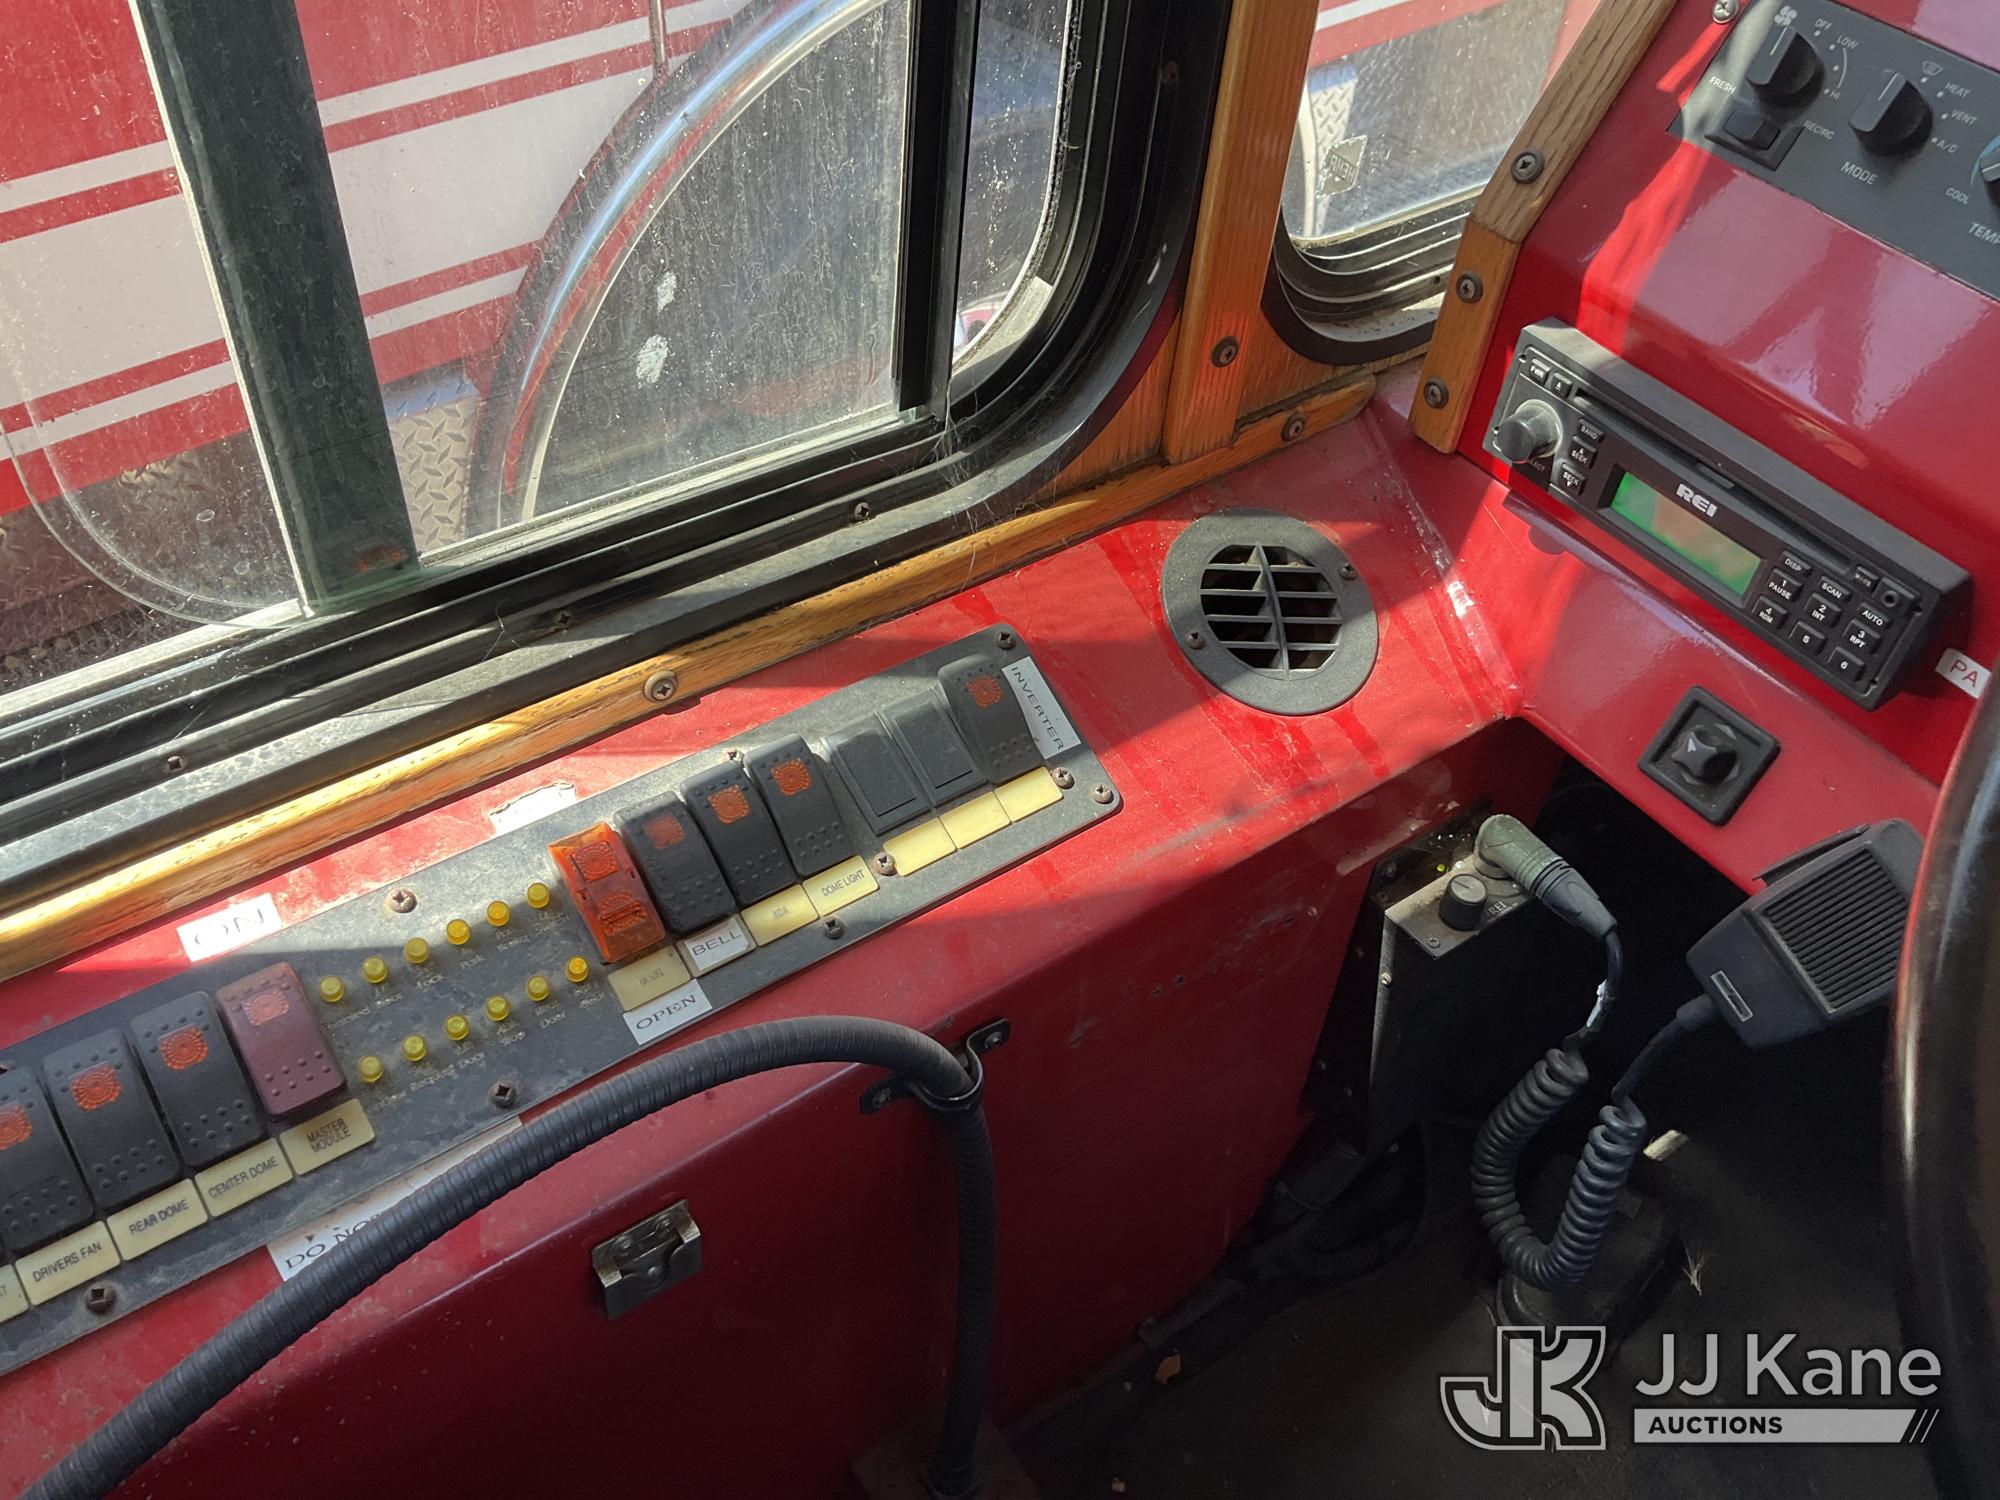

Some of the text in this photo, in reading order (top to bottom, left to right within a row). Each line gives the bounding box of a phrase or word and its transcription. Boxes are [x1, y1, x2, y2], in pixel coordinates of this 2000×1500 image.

[1814, 18, 1833, 31] OFF
[1837, 35, 1859, 50] LOW
[1709, 76, 1737, 94] FRESH
[1945, 82, 1971, 98] HEAT
[1829, 90, 1841, 100] HI
[1950, 108, 1978, 126] VENT
[1803, 120, 1835, 140] RECIRC
[1937, 139, 1959, 154] A/C
[1840, 161, 1878, 185] MODE
[1945, 187, 1970, 205] COOL
[1580, 424, 1599, 441] BAND
[1571, 449, 1588, 465] SEEK
[1562, 471, 1580, 486] SEEK
[1676, 483, 1718, 518] REI
[1784, 557, 1802, 572] DISP
[1768, 582, 1792, 600] PAUSE
[1781, 578, 1788, 588] 1
[1821, 582, 1843, 599] SCAN
[1765, 606, 1772, 615] 4
[1811, 608, 1825, 622] INT
[1817, 603, 1827, 613] 2
[1862, 609, 1884, 627] AUTO
[1803, 634, 1811, 644] 5
[1849, 635, 1866, 649] RPT
[1857, 630, 1866, 639] 3
[1840, 660, 1848, 670] 6
[1949, 658, 1980, 689] PA
[1011, 666, 1064, 750] INVERTER
[820, 868, 866, 898] DOME LIGHT
[1488, 900, 1507, 915] REI
[692, 930, 743, 957] BELL
[636, 995, 697, 1030] OPEN
[306, 1117, 347, 1143] MASTER
[310, 1128, 352, 1152] MODULE
[207, 1157, 280, 1199] CENTER DOME
[128, 1199, 190, 1236] REAR DOME
[32, 1241, 104, 1283] DRIVERS FAN
[285, 1243, 326, 1270] DO
